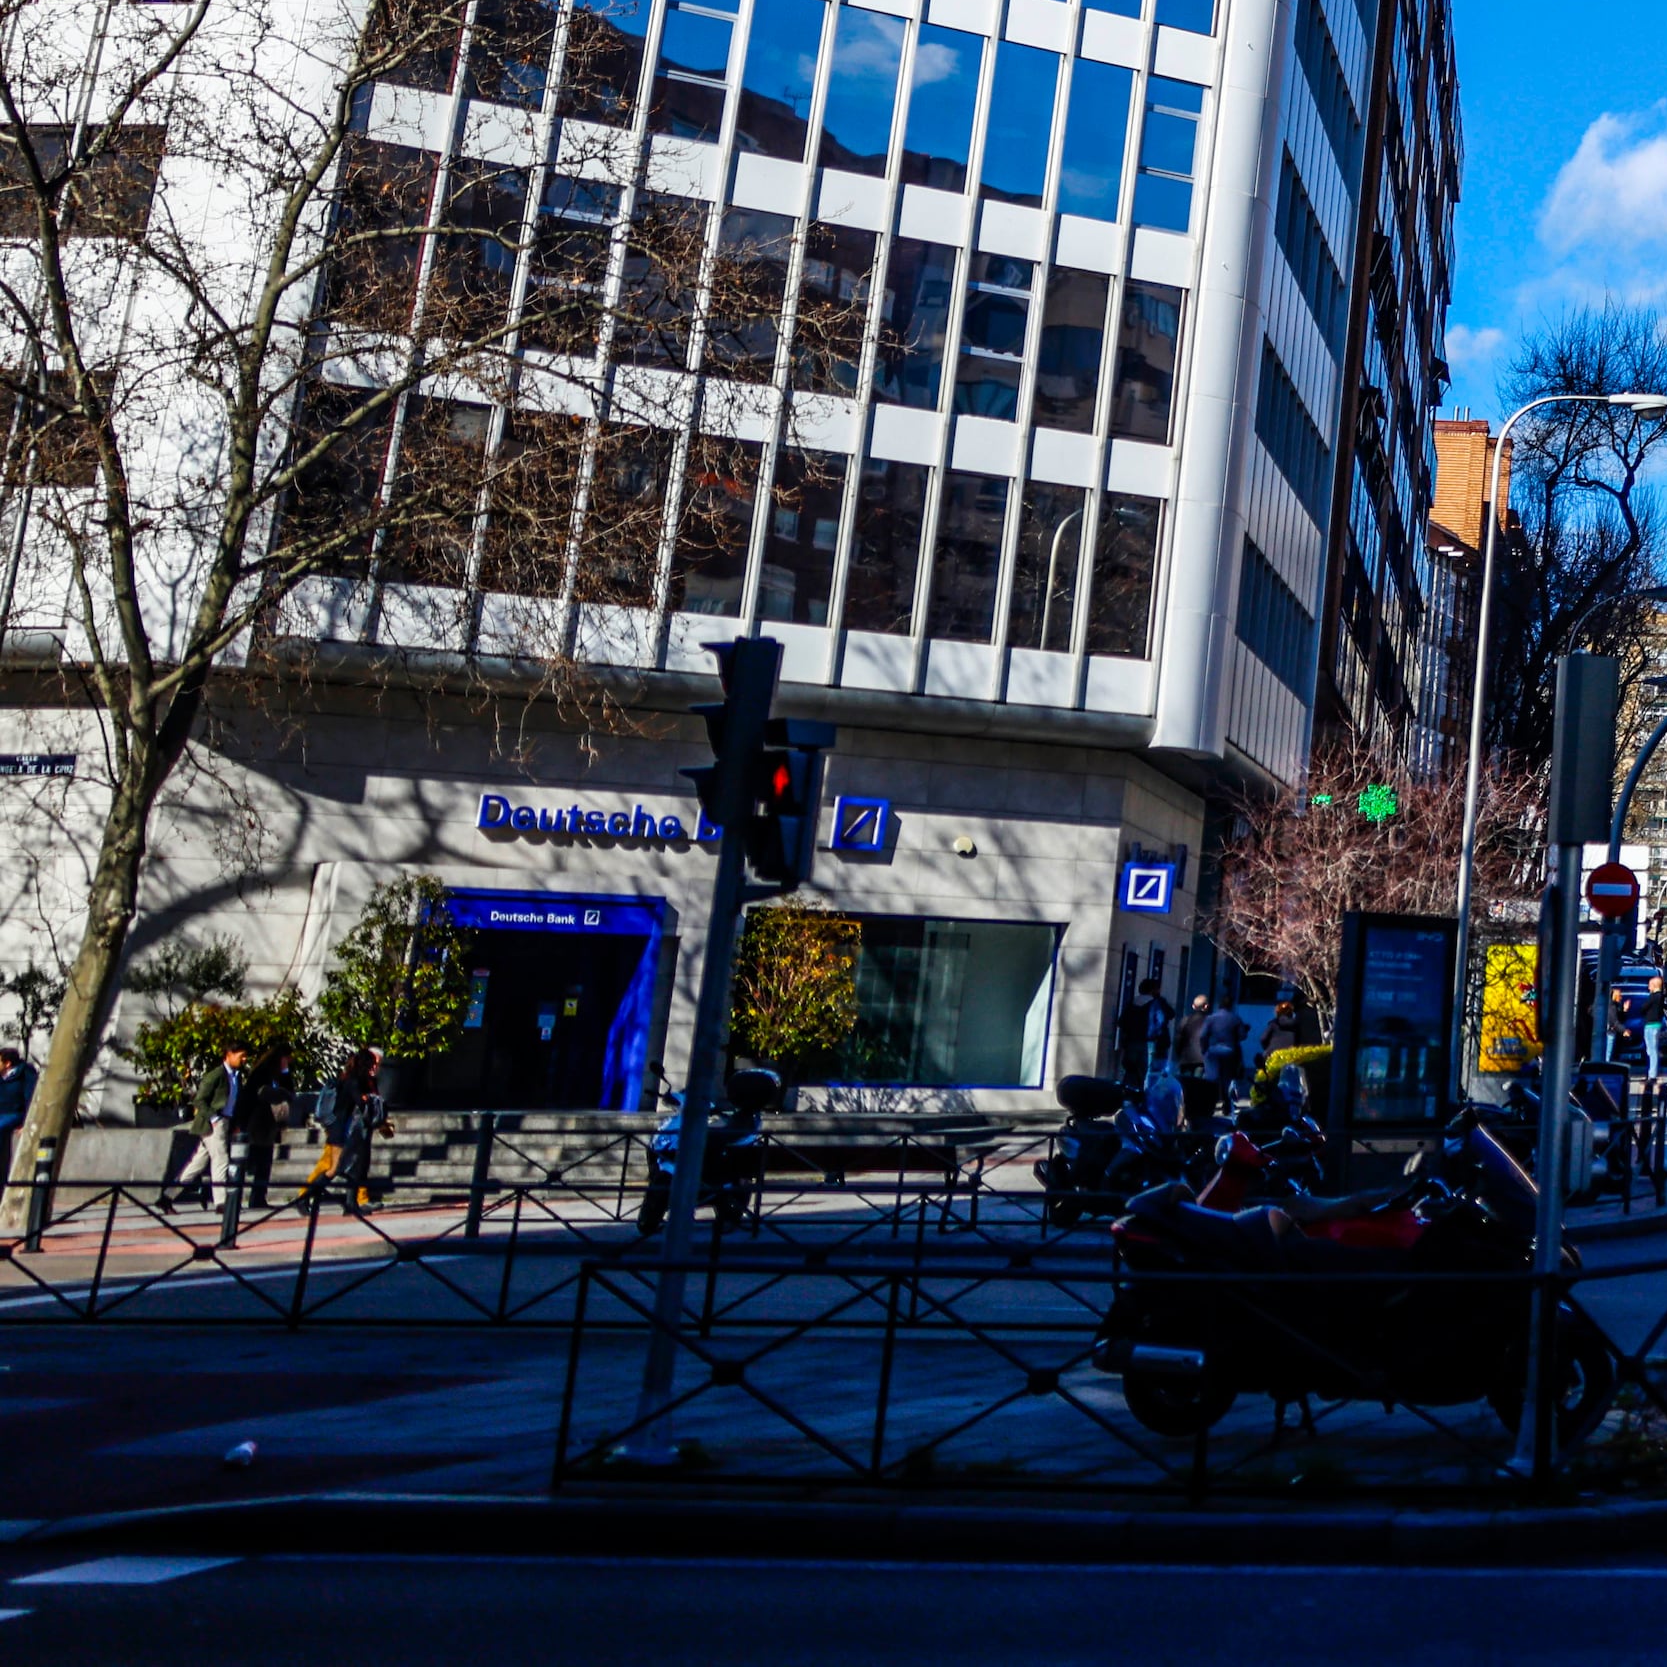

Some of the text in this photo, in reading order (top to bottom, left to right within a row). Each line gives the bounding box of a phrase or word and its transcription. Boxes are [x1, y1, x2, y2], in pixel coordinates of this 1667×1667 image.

[41, 764, 51, 774] LA
[476, 794, 681, 839] Deutsche
[490, 910, 575, 925] Deutsche Bank
